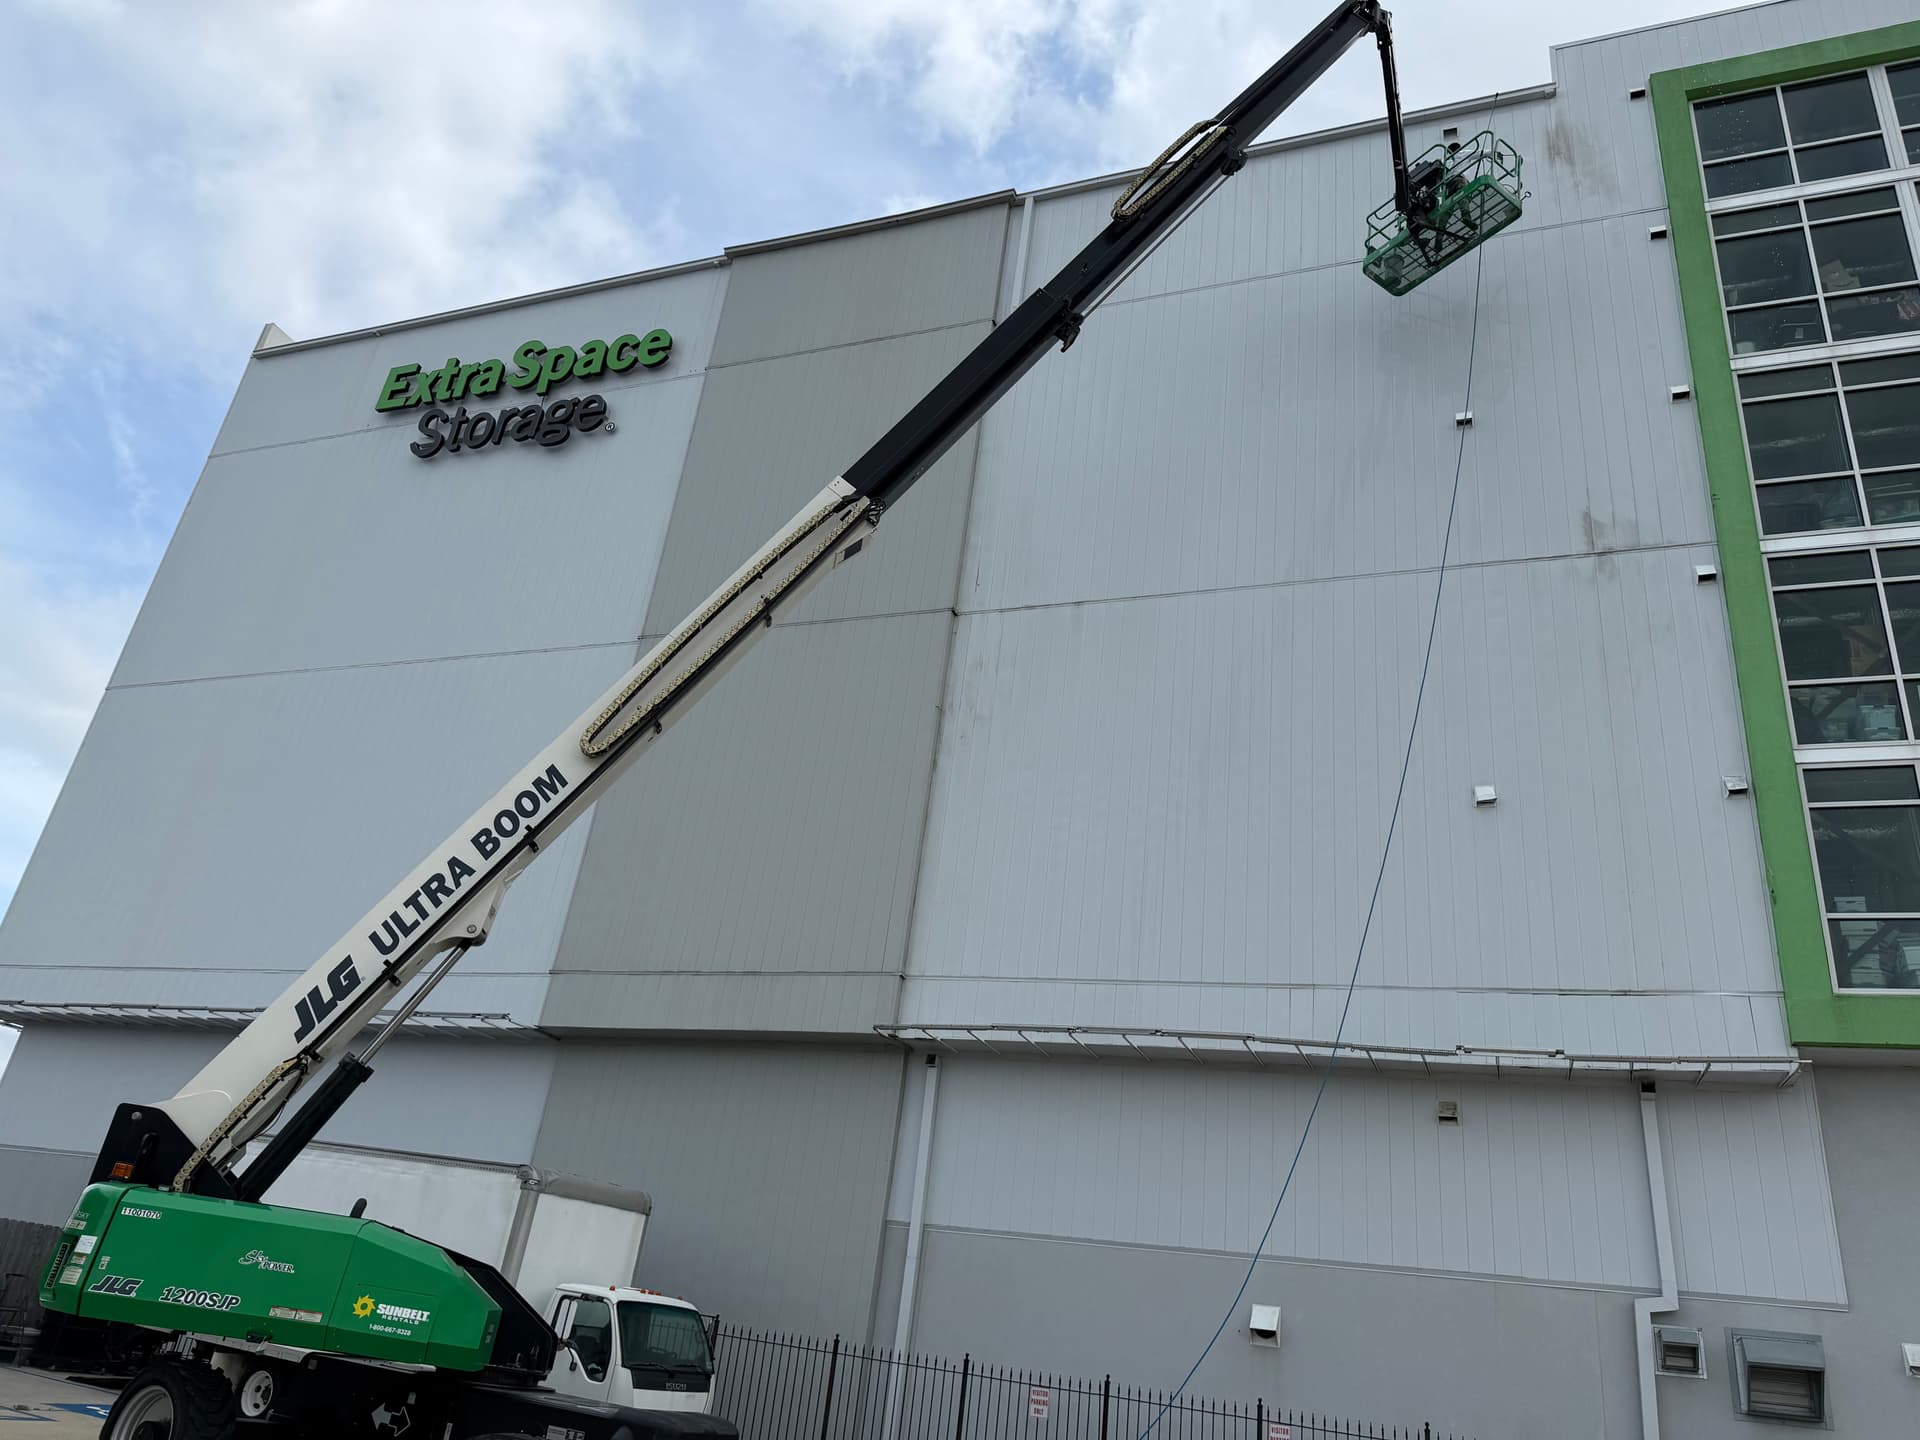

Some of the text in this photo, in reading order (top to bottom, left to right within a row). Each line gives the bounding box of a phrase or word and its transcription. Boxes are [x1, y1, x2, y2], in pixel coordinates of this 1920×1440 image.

[375, 328, 673, 413] Extra Space
[293, 763, 569, 1044] JLG ULTRA BOOM
[121, 1207, 162, 1220] 11001070
[88, 1274, 144, 1298] JLG
[159, 1286, 241, 1311] 1200SJP
[376, 1303, 431, 1322] SUNBELT
[381, 1314, 420, 1325] RENTALS
